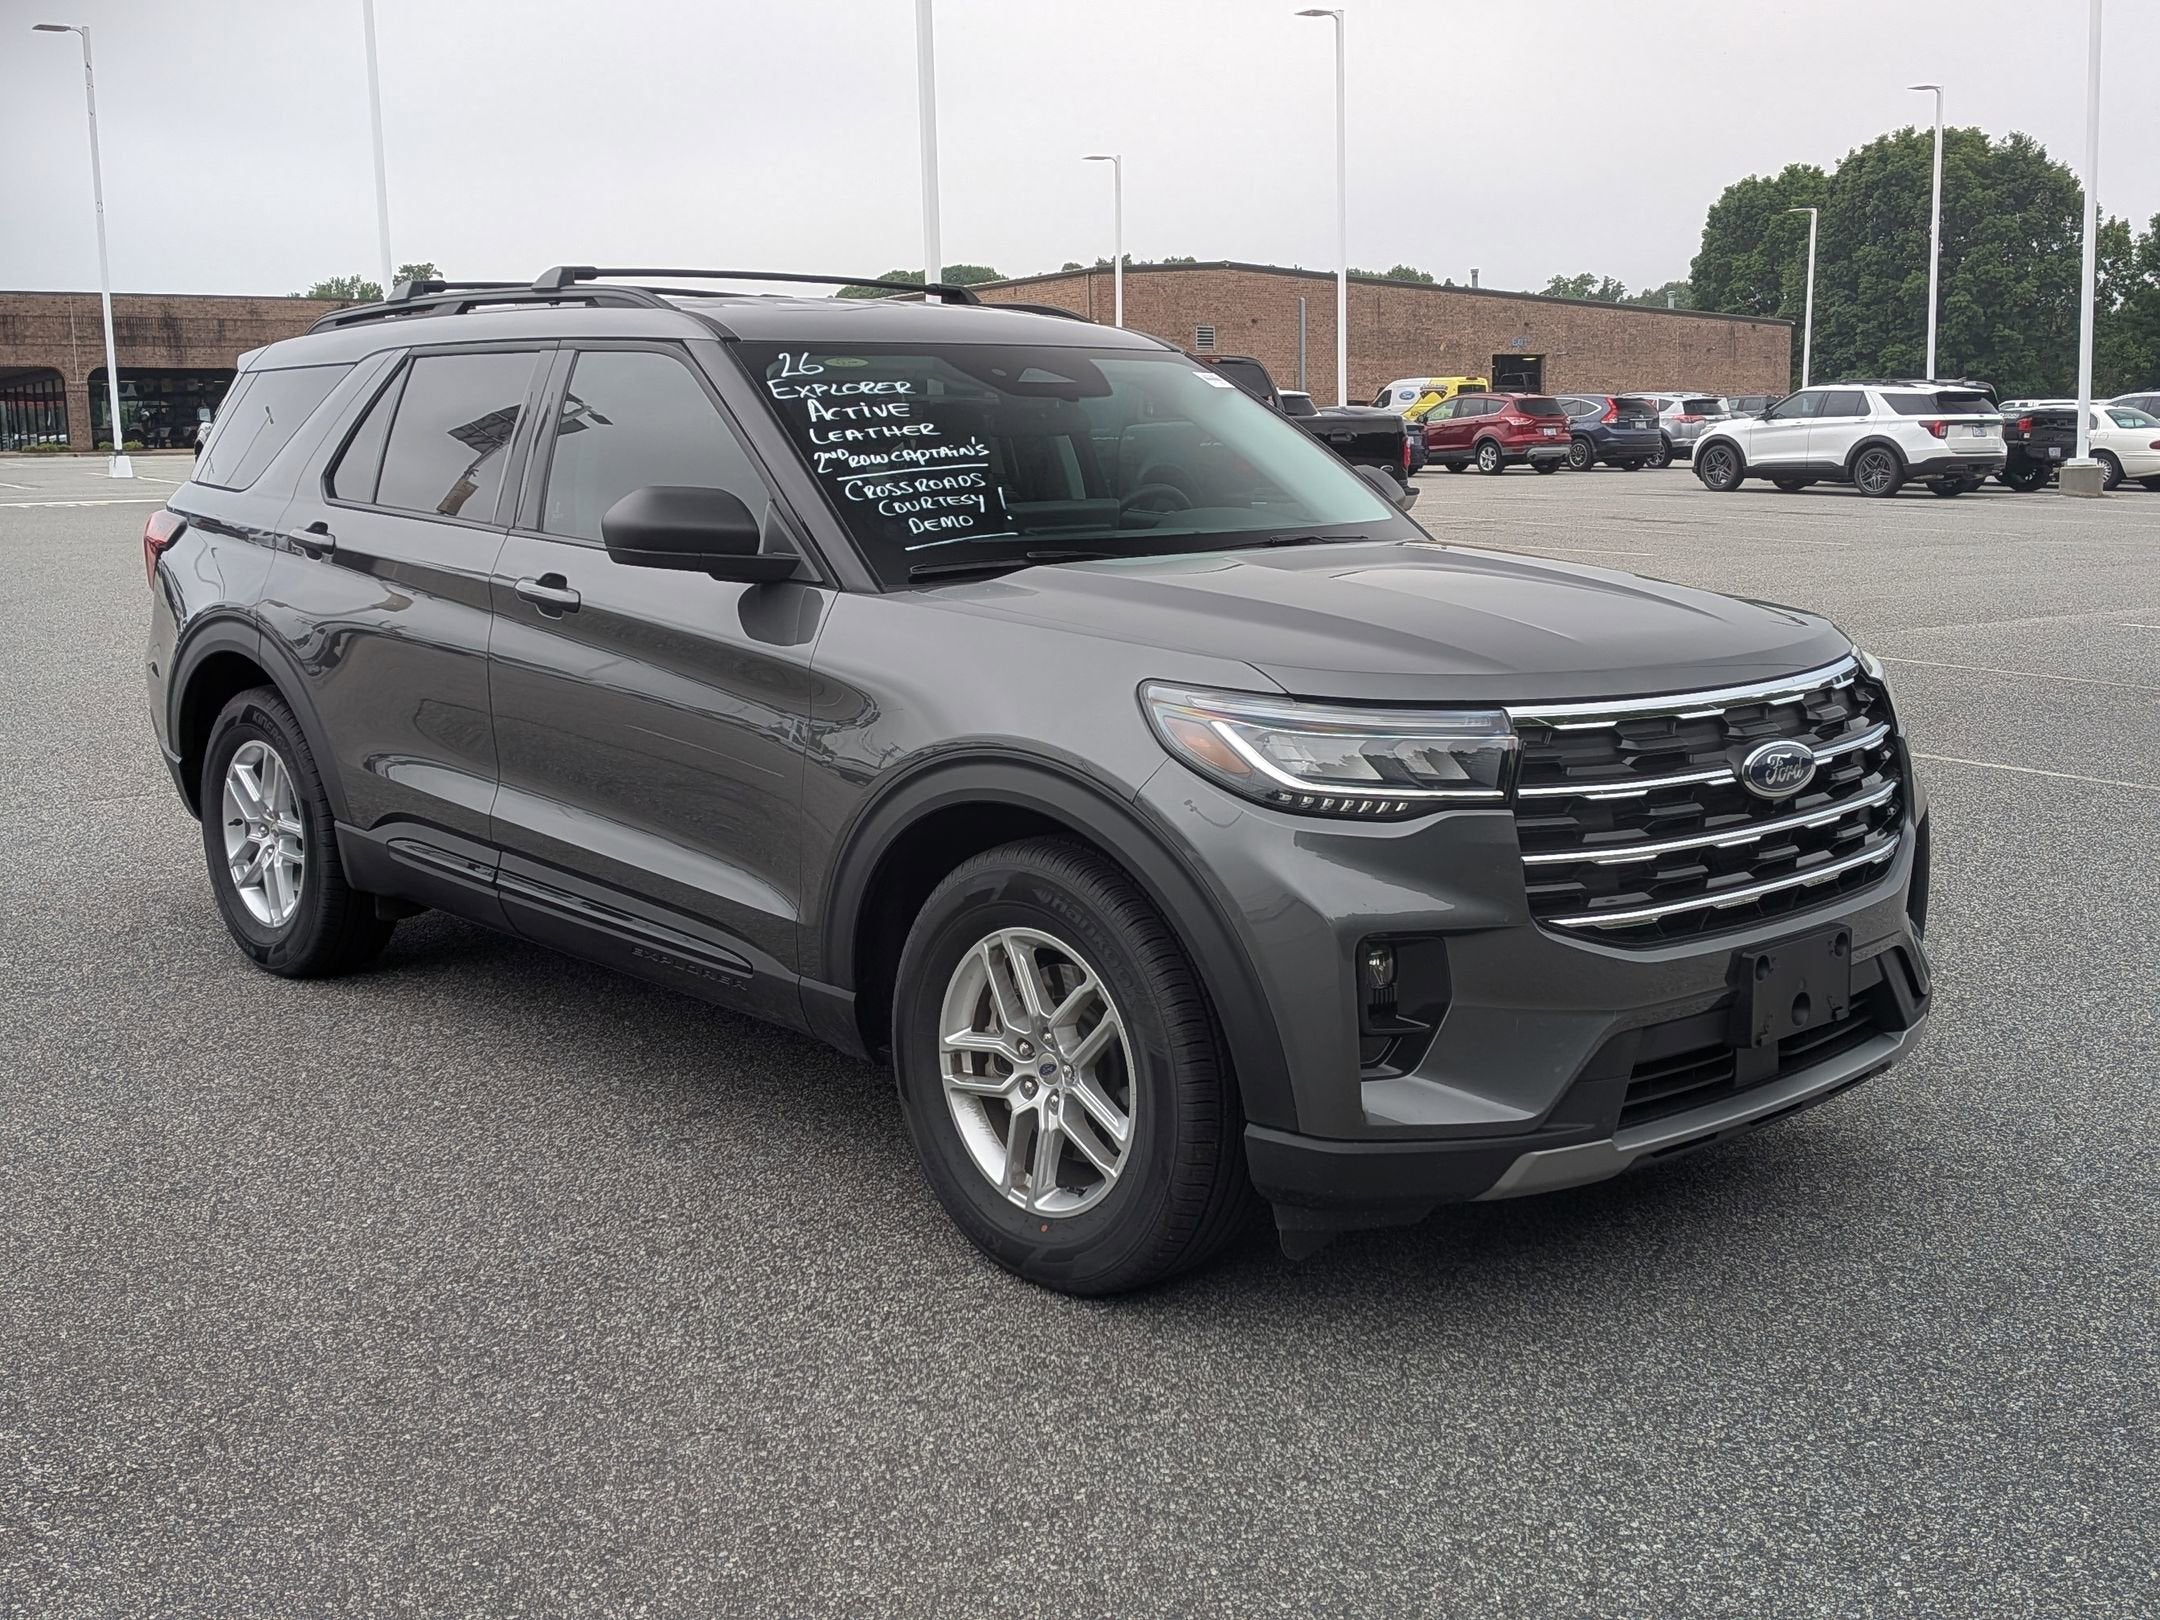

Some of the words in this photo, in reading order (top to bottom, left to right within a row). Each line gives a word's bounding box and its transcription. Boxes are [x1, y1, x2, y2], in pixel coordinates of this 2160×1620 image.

[778, 352, 824, 378] 26
[766, 379, 916, 399] EXPLORER
[807, 399, 911, 422] ACTIVE
[809, 422, 942, 445] LEATHER
[849, 453, 889, 469] ROW
[908, 515, 974, 536] DEMO
[1765, 752, 1804, 785] Ford
[631, 946, 748, 991] EXPLORER
